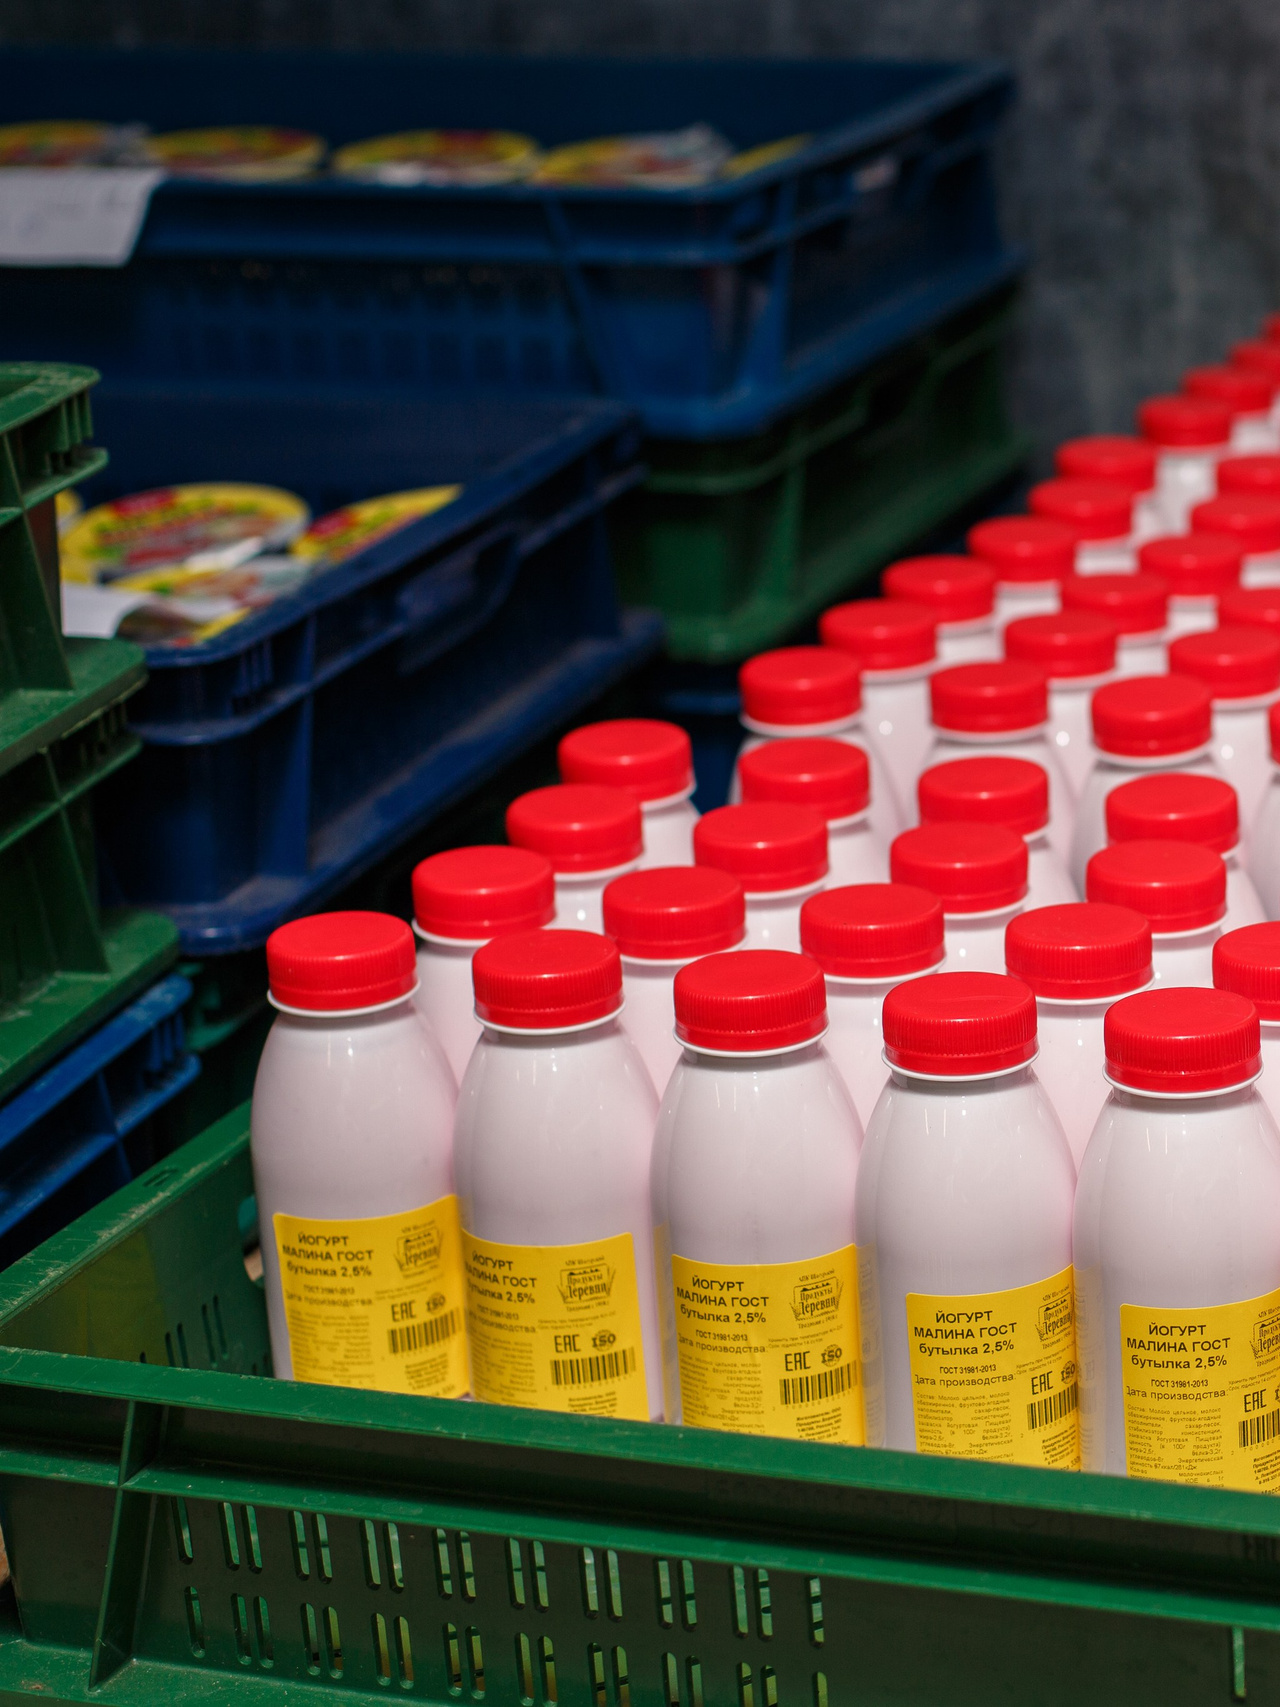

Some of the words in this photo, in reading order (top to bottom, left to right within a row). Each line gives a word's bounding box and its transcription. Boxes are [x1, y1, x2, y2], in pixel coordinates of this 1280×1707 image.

[298, 1231, 348, 1246] ЙОГУРТ
[337, 1250, 373, 1261] ГОСТ
[472, 1250, 513, 1271] ЙОГУРТ
[287, 1261, 336, 1276] бутылка
[341, 1266, 372, 1277] 2,5%
[503, 1275, 536, 1288] ГОСТ
[692, 1274, 744, 1292] ЙОГУРТ
[506, 1291, 535, 1304] 2,5%
[677, 1287, 727, 1307] МАЛИНА
[731, 1297, 769, 1307] ГОСТ
[681, 1304, 730, 1323] бутылка
[734, 1312, 766, 1324] 2,5%
[936, 1310, 993, 1324] ЙОГУРТ
[696, 1330, 711, 1340] ГОСТ
[713, 1333, 748, 1341] 31981-2013
[914, 1327, 975, 1339] МАЛИНА
[980, 1323, 1017, 1338] ГОСТ
[1149, 1322, 1206, 1335] ЙОГУРТ
[555, 1334, 580, 1353] EAC
[592, 1332, 616, 1348] ISO
[919, 1343, 978, 1356] бутылка
[982, 1340, 1014, 1354] 2,5%
[1127, 1338, 1187, 1352] МАЛИНА
[1192, 1338, 1230, 1351] ГОСТ
[785, 1351, 811, 1371] EAC
[821, 1348, 842, 1364] ISO
[1132, 1355, 1190, 1369] бутылка
[1195, 1355, 1227, 1369] 2,5%
[940, 1366, 958, 1374] ГОСТ
[960, 1364, 996, 1374] 31981-2013
[1061, 1365, 1075, 1382] ISO
[1031, 1371, 1053, 1395] EAC
[1151, 1379, 1169, 1388] ГОСТ
[1171, 1379, 1208, 1388] 31981-2013
[1244, 1389, 1267, 1412] EAC
